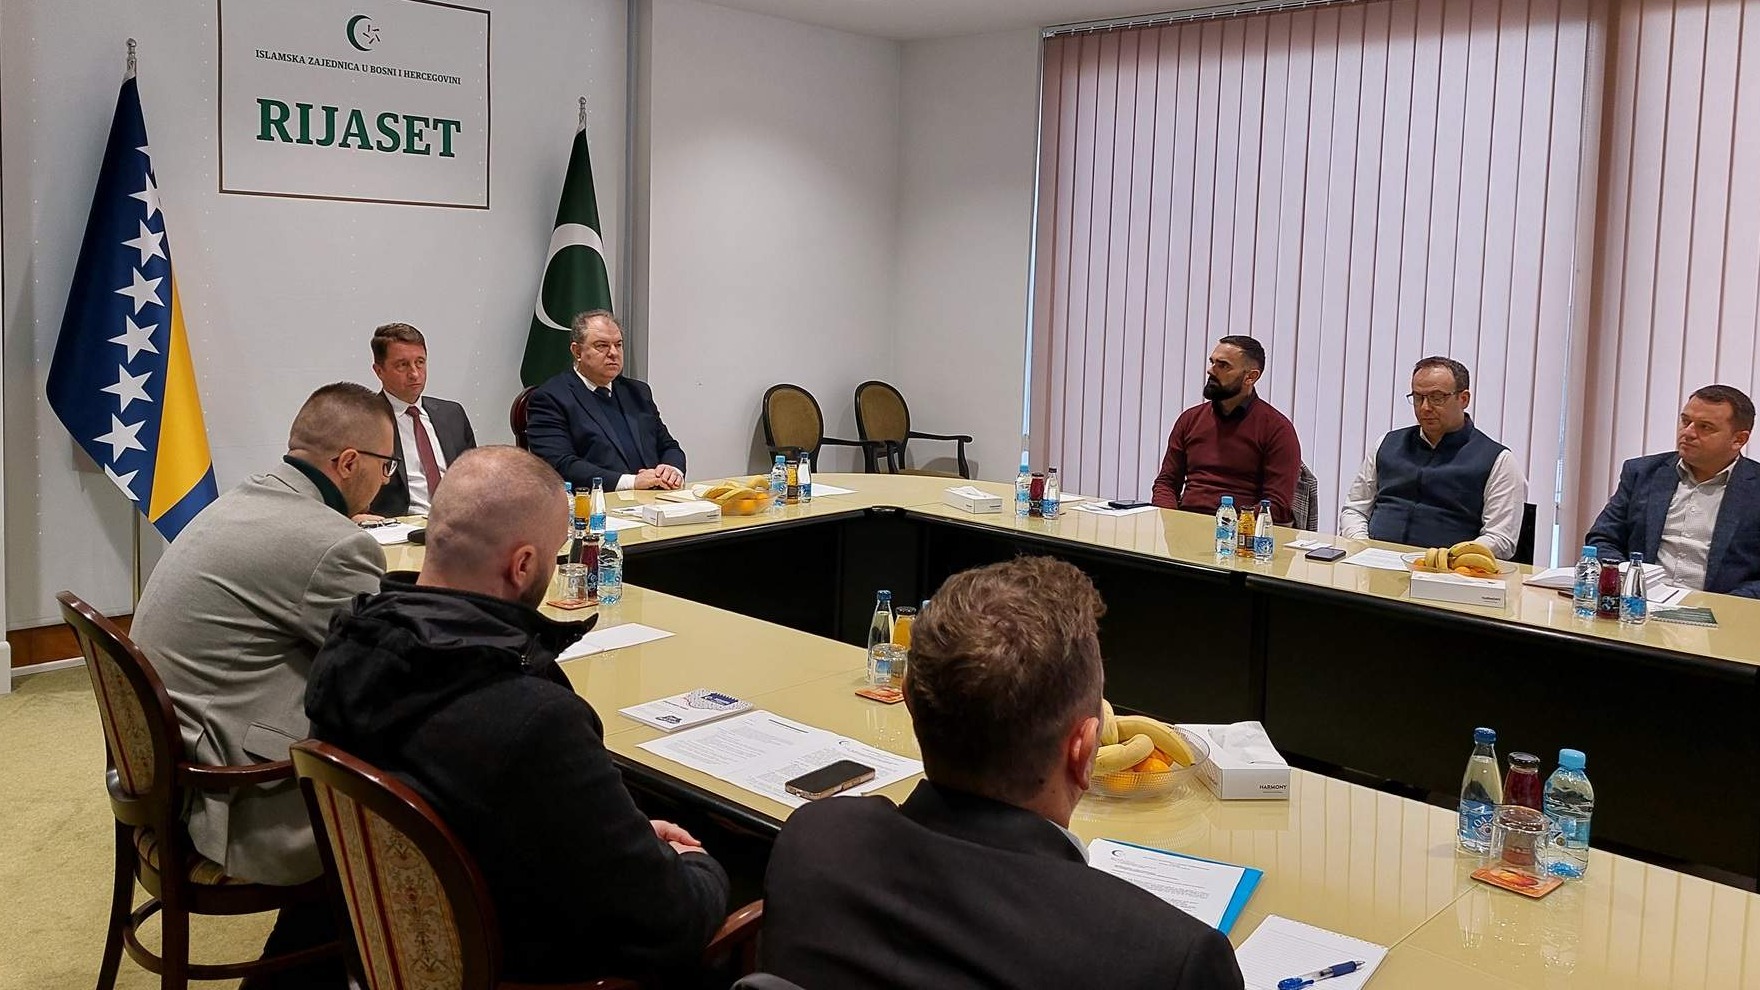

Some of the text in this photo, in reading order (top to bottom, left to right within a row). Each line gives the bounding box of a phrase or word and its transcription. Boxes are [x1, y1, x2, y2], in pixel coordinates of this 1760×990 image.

[255, 49, 461, 85] ISLAMSKA ZAJEDNICA U BOSNI I HERCEGOVINI
[256, 98, 461, 157] RIJASET
